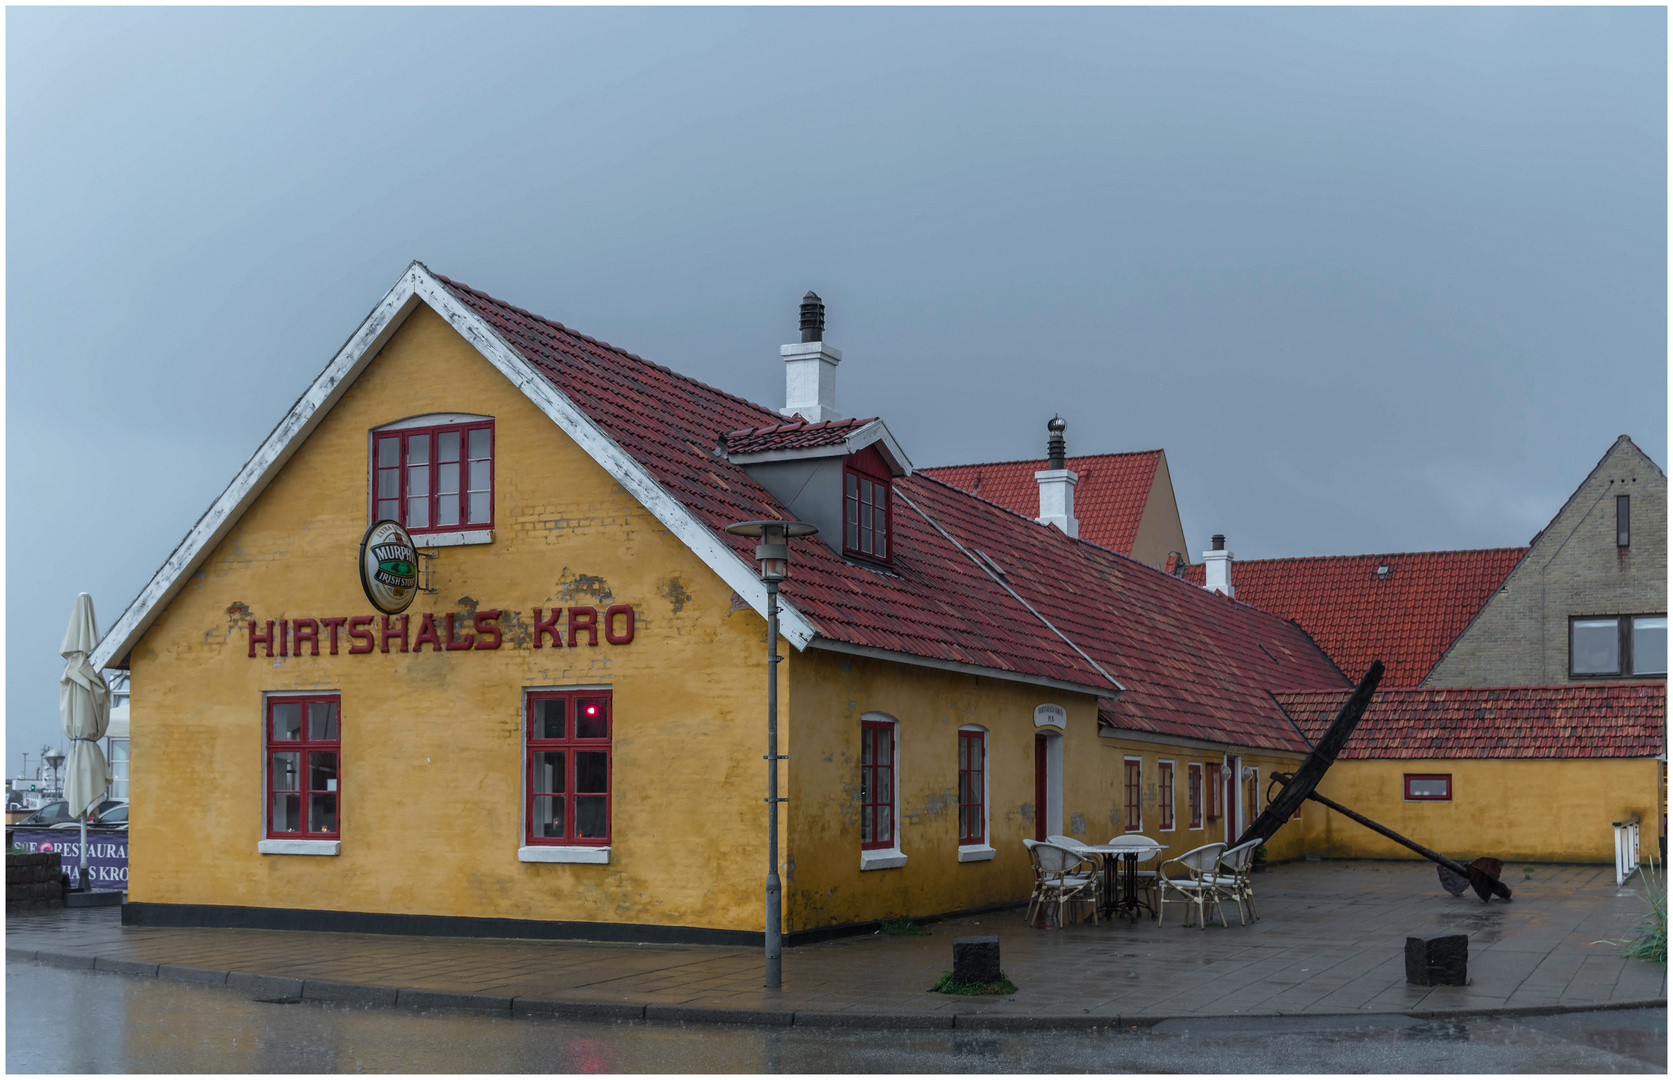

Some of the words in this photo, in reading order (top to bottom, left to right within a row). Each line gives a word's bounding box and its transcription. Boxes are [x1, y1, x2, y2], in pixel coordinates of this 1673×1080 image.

[379, 571, 401, 586] IRISH
[247, 609, 503, 658] HIRTSHALS
[533, 604, 635, 650] KRO
[99, 866, 128, 881] KRO
